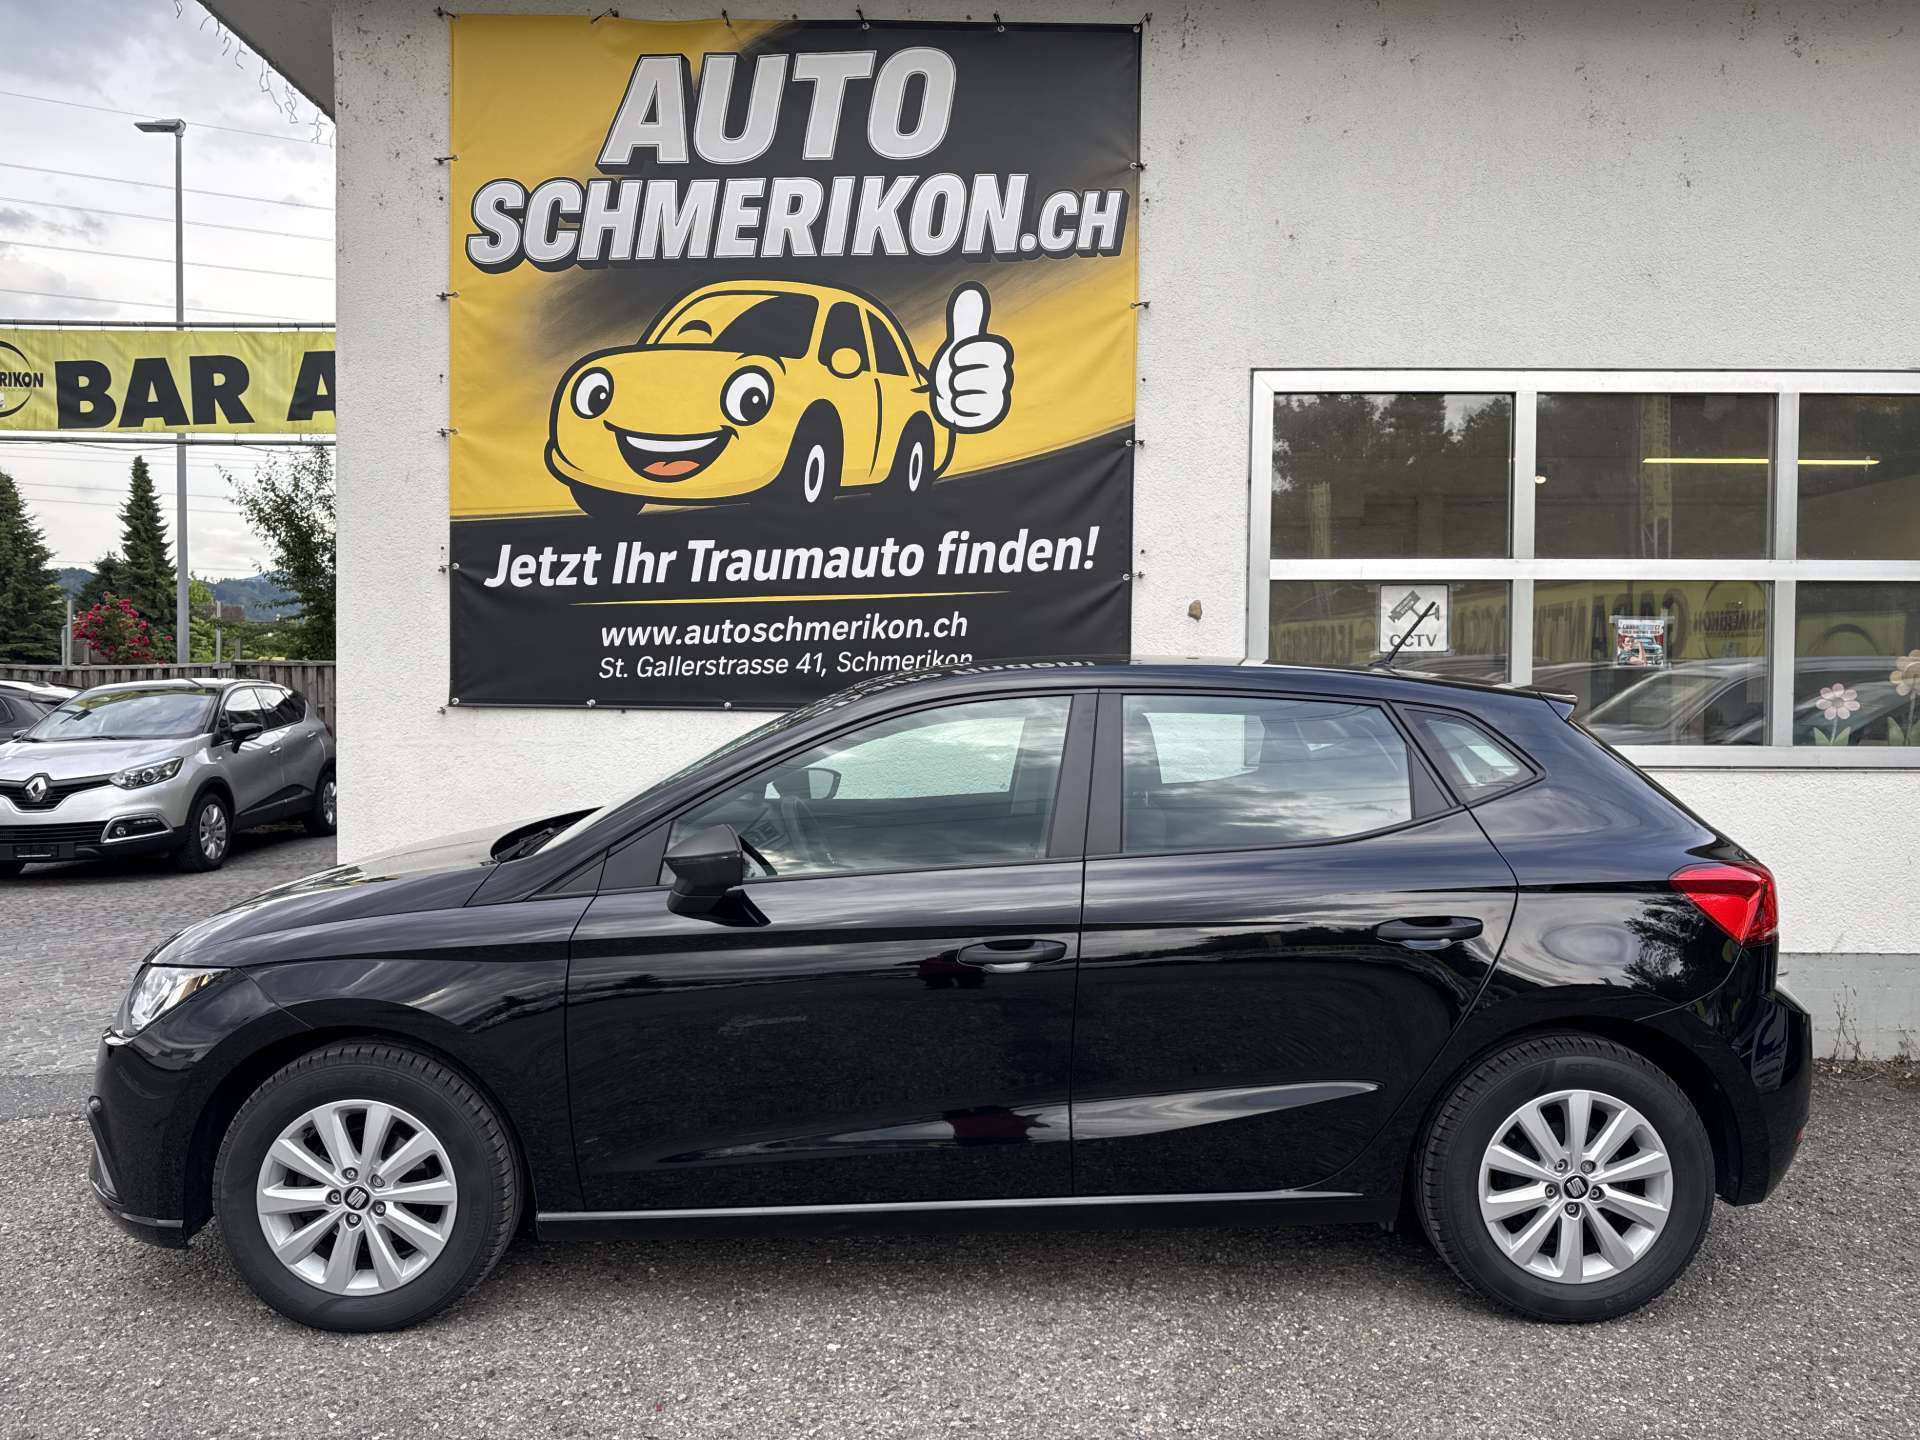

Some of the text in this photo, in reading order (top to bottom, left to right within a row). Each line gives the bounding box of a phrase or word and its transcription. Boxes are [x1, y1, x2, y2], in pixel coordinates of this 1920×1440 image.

[597, 46, 957, 165] AUTO
[467, 173, 1124, 265] SCHMERIKON.CH
[54, 350, 336, 430] BAR A
[483, 525, 1101, 588] Jetzt Ihr Traumauto finden!
[601, 610, 968, 647] www.autoschmerikon.ch
[1389, 633, 1437, 648] CCTV
[598, 657, 629, 679] St.
[636, 655, 789, 678] Gallerstrasse
[795, 652, 827, 678] 41,
[836, 649, 973, 673] Schmerikon
